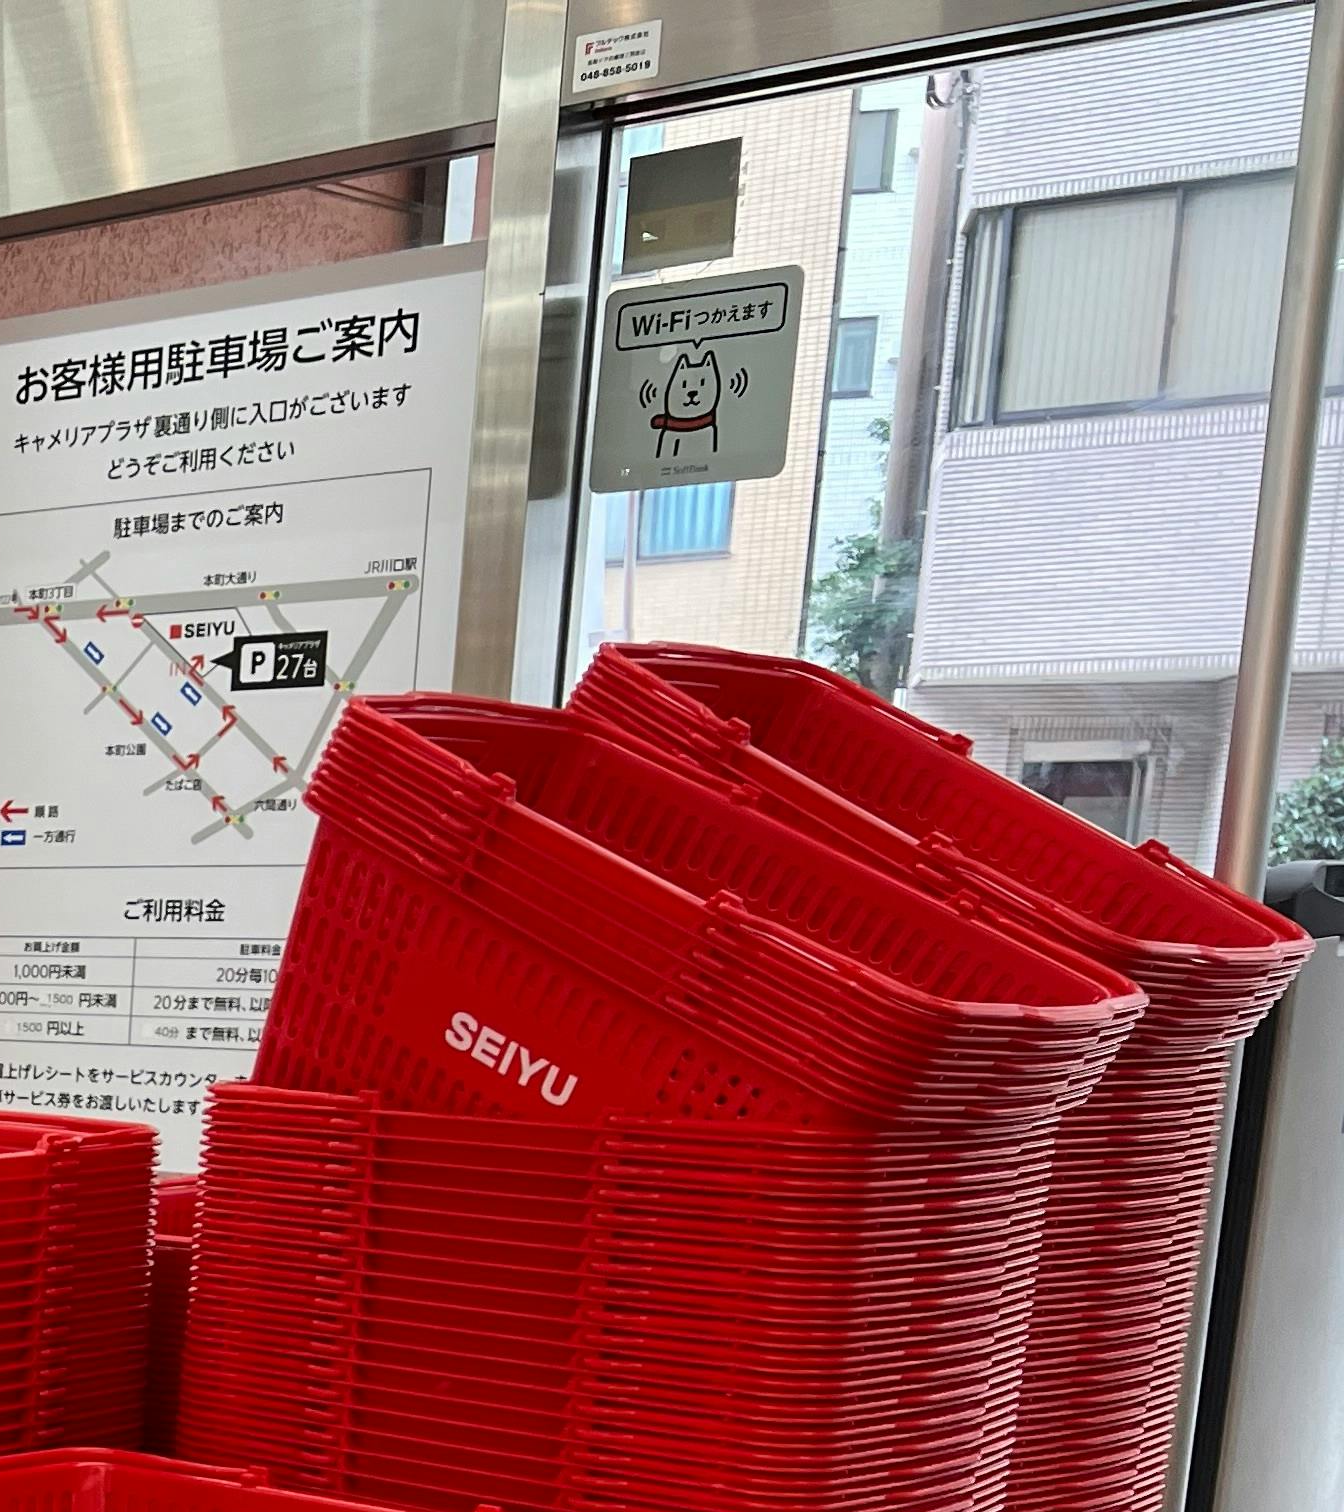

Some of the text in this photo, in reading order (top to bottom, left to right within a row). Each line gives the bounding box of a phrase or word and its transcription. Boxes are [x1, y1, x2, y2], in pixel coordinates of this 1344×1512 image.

[580, 60, 652, 82] 048-858-5019
[15, 307, 420, 407] お客様用駐車場ご案内
[13, 383, 412, 455] キャメリアプラザ裏通り側に入口がございます
[106, 439, 297, 481] どうぞご利用ください
[113, 502, 285, 541] 駐車場までのご案内
[363, 557, 418, 576] JR川口駅
[202, 571, 258, 587] 本町大通り
[28, 585, 75, 600] 本町3丁目
[184, 621, 236, 639] SEIYU
[250, 651, 319, 681] P 27台
[104, 743, 147, 757] 本町公園
[164, 779, 203, 793] たばこ店
[32, 830, 77, 844] 一方通行
[123, 897, 227, 923] ご利用料金
[13, 963, 87, 980] 1,000円未満
[78, 992, 118, 1009] 円未満
[16, 1021, 85, 1037] 1500 円以上
[444, 1011, 578, 1106] SEIYU
